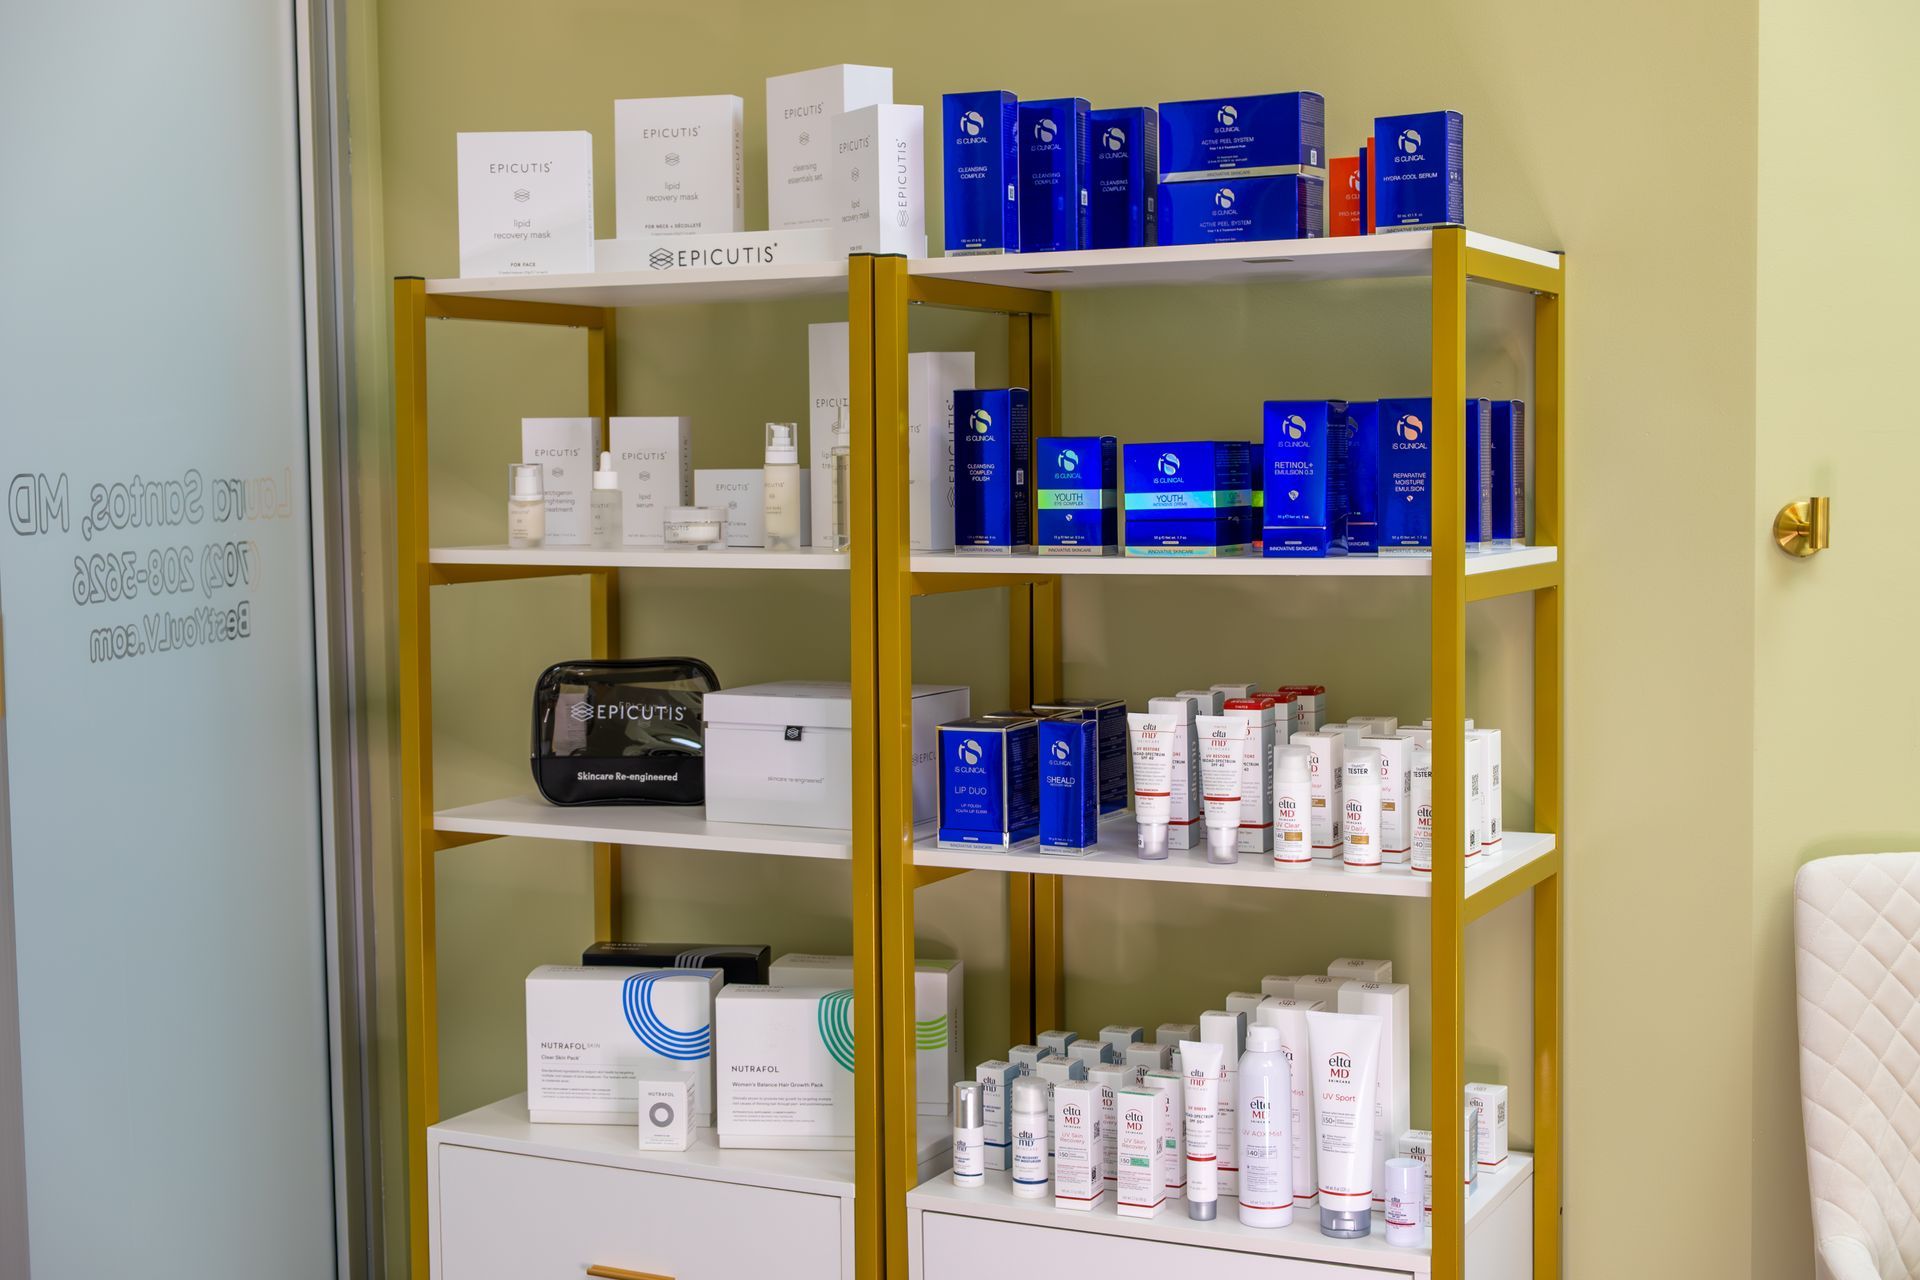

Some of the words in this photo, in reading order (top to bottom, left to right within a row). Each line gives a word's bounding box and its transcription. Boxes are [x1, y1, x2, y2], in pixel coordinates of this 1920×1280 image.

[783, 104, 822, 120] EPICUTIS
[643, 127, 699, 139] EPICUTIS
[839, 137, 869, 154] EPICUTIS
[1201, 138, 1219, 146] ACTIVE
[1105, 152, 1128, 160] CLINICAL
[1401, 154, 1425, 162] CLINICAL
[489, 162, 552, 174] EPICUTIS
[958, 165, 988, 173] CLEANSING
[897, 141, 907, 207] EPICUTIS
[1418, 172, 1438, 180] SERUM
[664, 182, 680, 192] lipid
[1100, 179, 1128, 187] CLEANSING
[646, 194, 678, 204] recovery
[679, 192, 699, 200] mask
[513, 219, 531, 229] lipid
[493, 231, 528, 241] recovery
[530, 230, 551, 239] mask
[678, 246, 774, 267] EPICUTIS
[1284, 440, 1310, 448] CLINICAL
[1400, 442, 1427, 450] CLINICAL
[534, 449, 579, 457] EPICUTIS
[622, 452, 665, 460] EPICUTIS
[716, 483, 748, 491] EPICUTIS
[1054, 493, 1083, 501] YOUTH
[1156, 495, 1183, 503] YOUTH
[597, 704, 684, 721] EPICUTIS
[1142, 722, 1156, 731] elta
[1212, 729, 1226, 738] elta
[1348, 767, 1368, 775] TESTER
[577, 771, 614, 781] Skincare
[615, 772, 678, 782] Re-engineered
[1046, 775, 1075, 785] SHEALD
[954, 786, 967, 794] LIP
[968, 786, 987, 795] DUO
[1278, 799, 1296, 809] elta
[1345, 802, 1362, 812] elta
[1279, 810, 1295, 818] MD
[1346, 812, 1361, 820] MD
[1351, 825, 1366, 833] Daily
[541, 1042, 586, 1050] NUTRAFOL
[1328, 1055, 1352, 1068] elta
[731, 1065, 779, 1073] NUTRAFOL
[1190, 1068, 1204, 1077] elta
[1330, 1068, 1350, 1079] MD
[983, 1076, 996, 1085] elta
[1335, 1093, 1356, 1102] Sport
[1250, 1100, 1271, 1110] elta
[1063, 1106, 1081, 1116] elta
[1064, 1116, 1080, 1125] MD
[1125, 1112, 1143, 1122] elta
[1126, 1122, 1143, 1131] MD
[1018, 1130, 1033, 1139] elta
[1060, 1137, 1085, 1145] Recovery
[1122, 1143, 1147, 1151] Recovery
